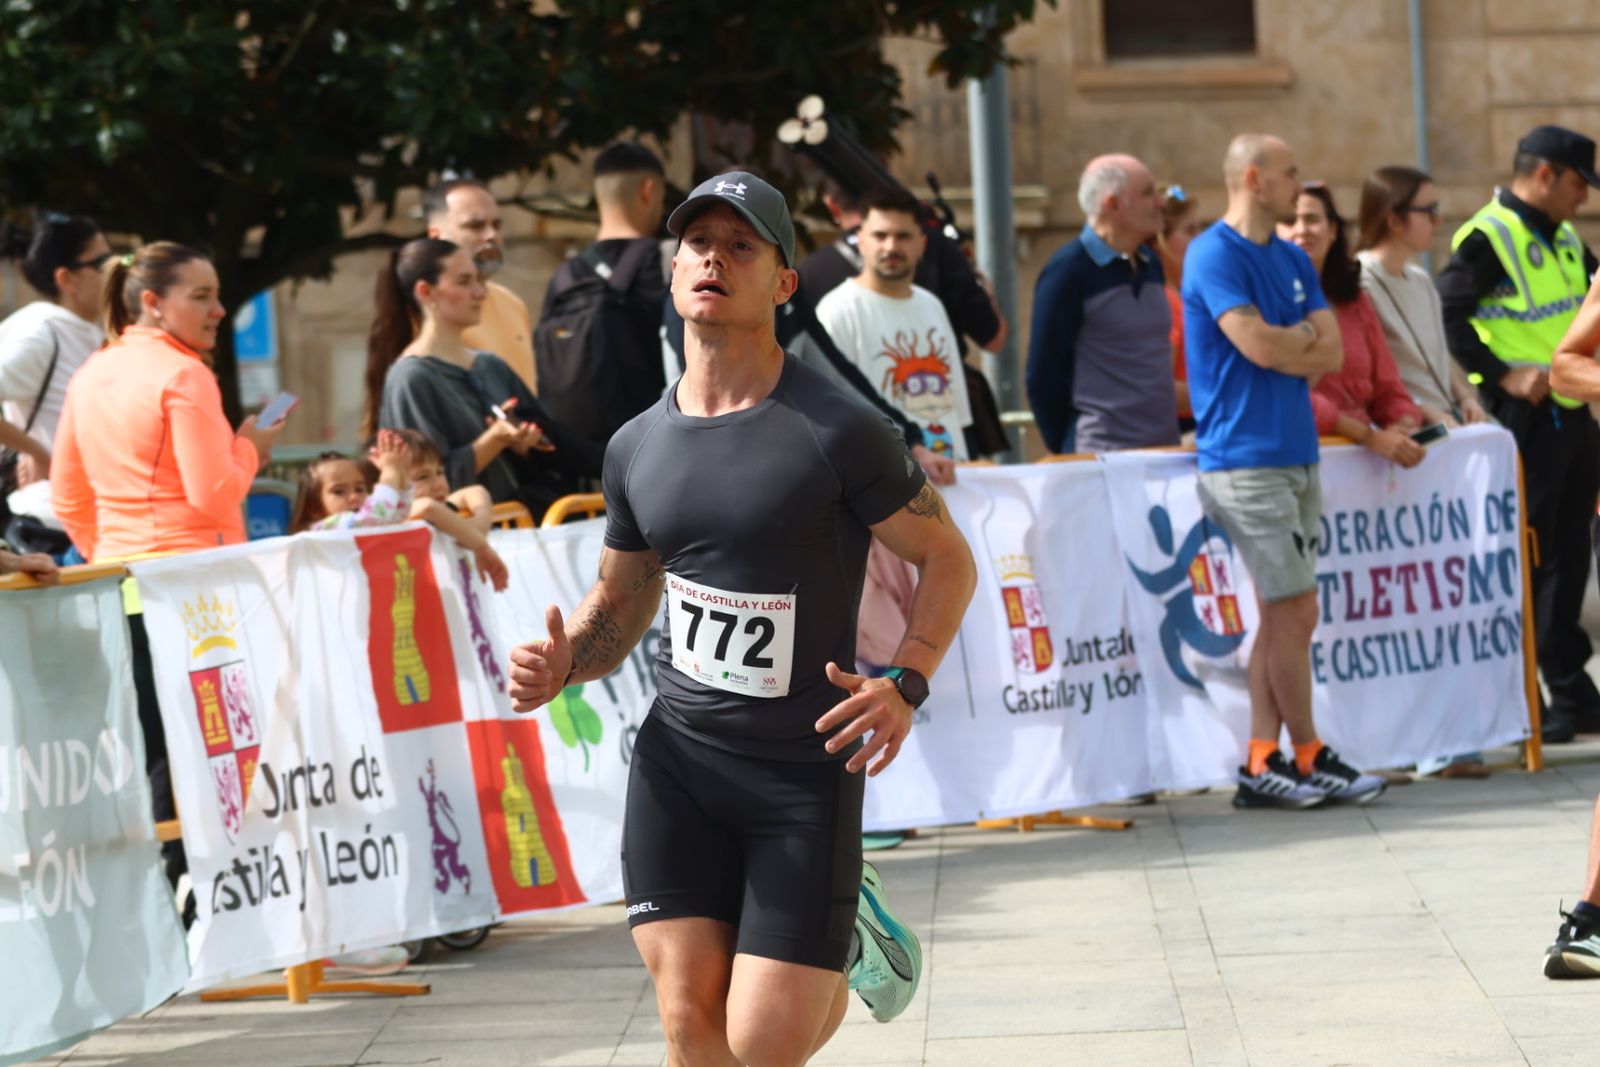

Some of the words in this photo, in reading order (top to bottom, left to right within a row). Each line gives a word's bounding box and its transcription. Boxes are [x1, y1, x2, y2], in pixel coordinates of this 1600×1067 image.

[670, 580, 685, 593] DÍA
[686, 587, 698, 599] DE
[700, 592, 749, 610] CASTILLA
[752, 601, 759, 610] Y
[761, 599, 791, 611] LEÓN
[1315, 546, 1517, 625] TLETISMO
[681, 600, 775, 669] 772
[351, 744, 383, 801] de
[320, 822, 399, 887] León
